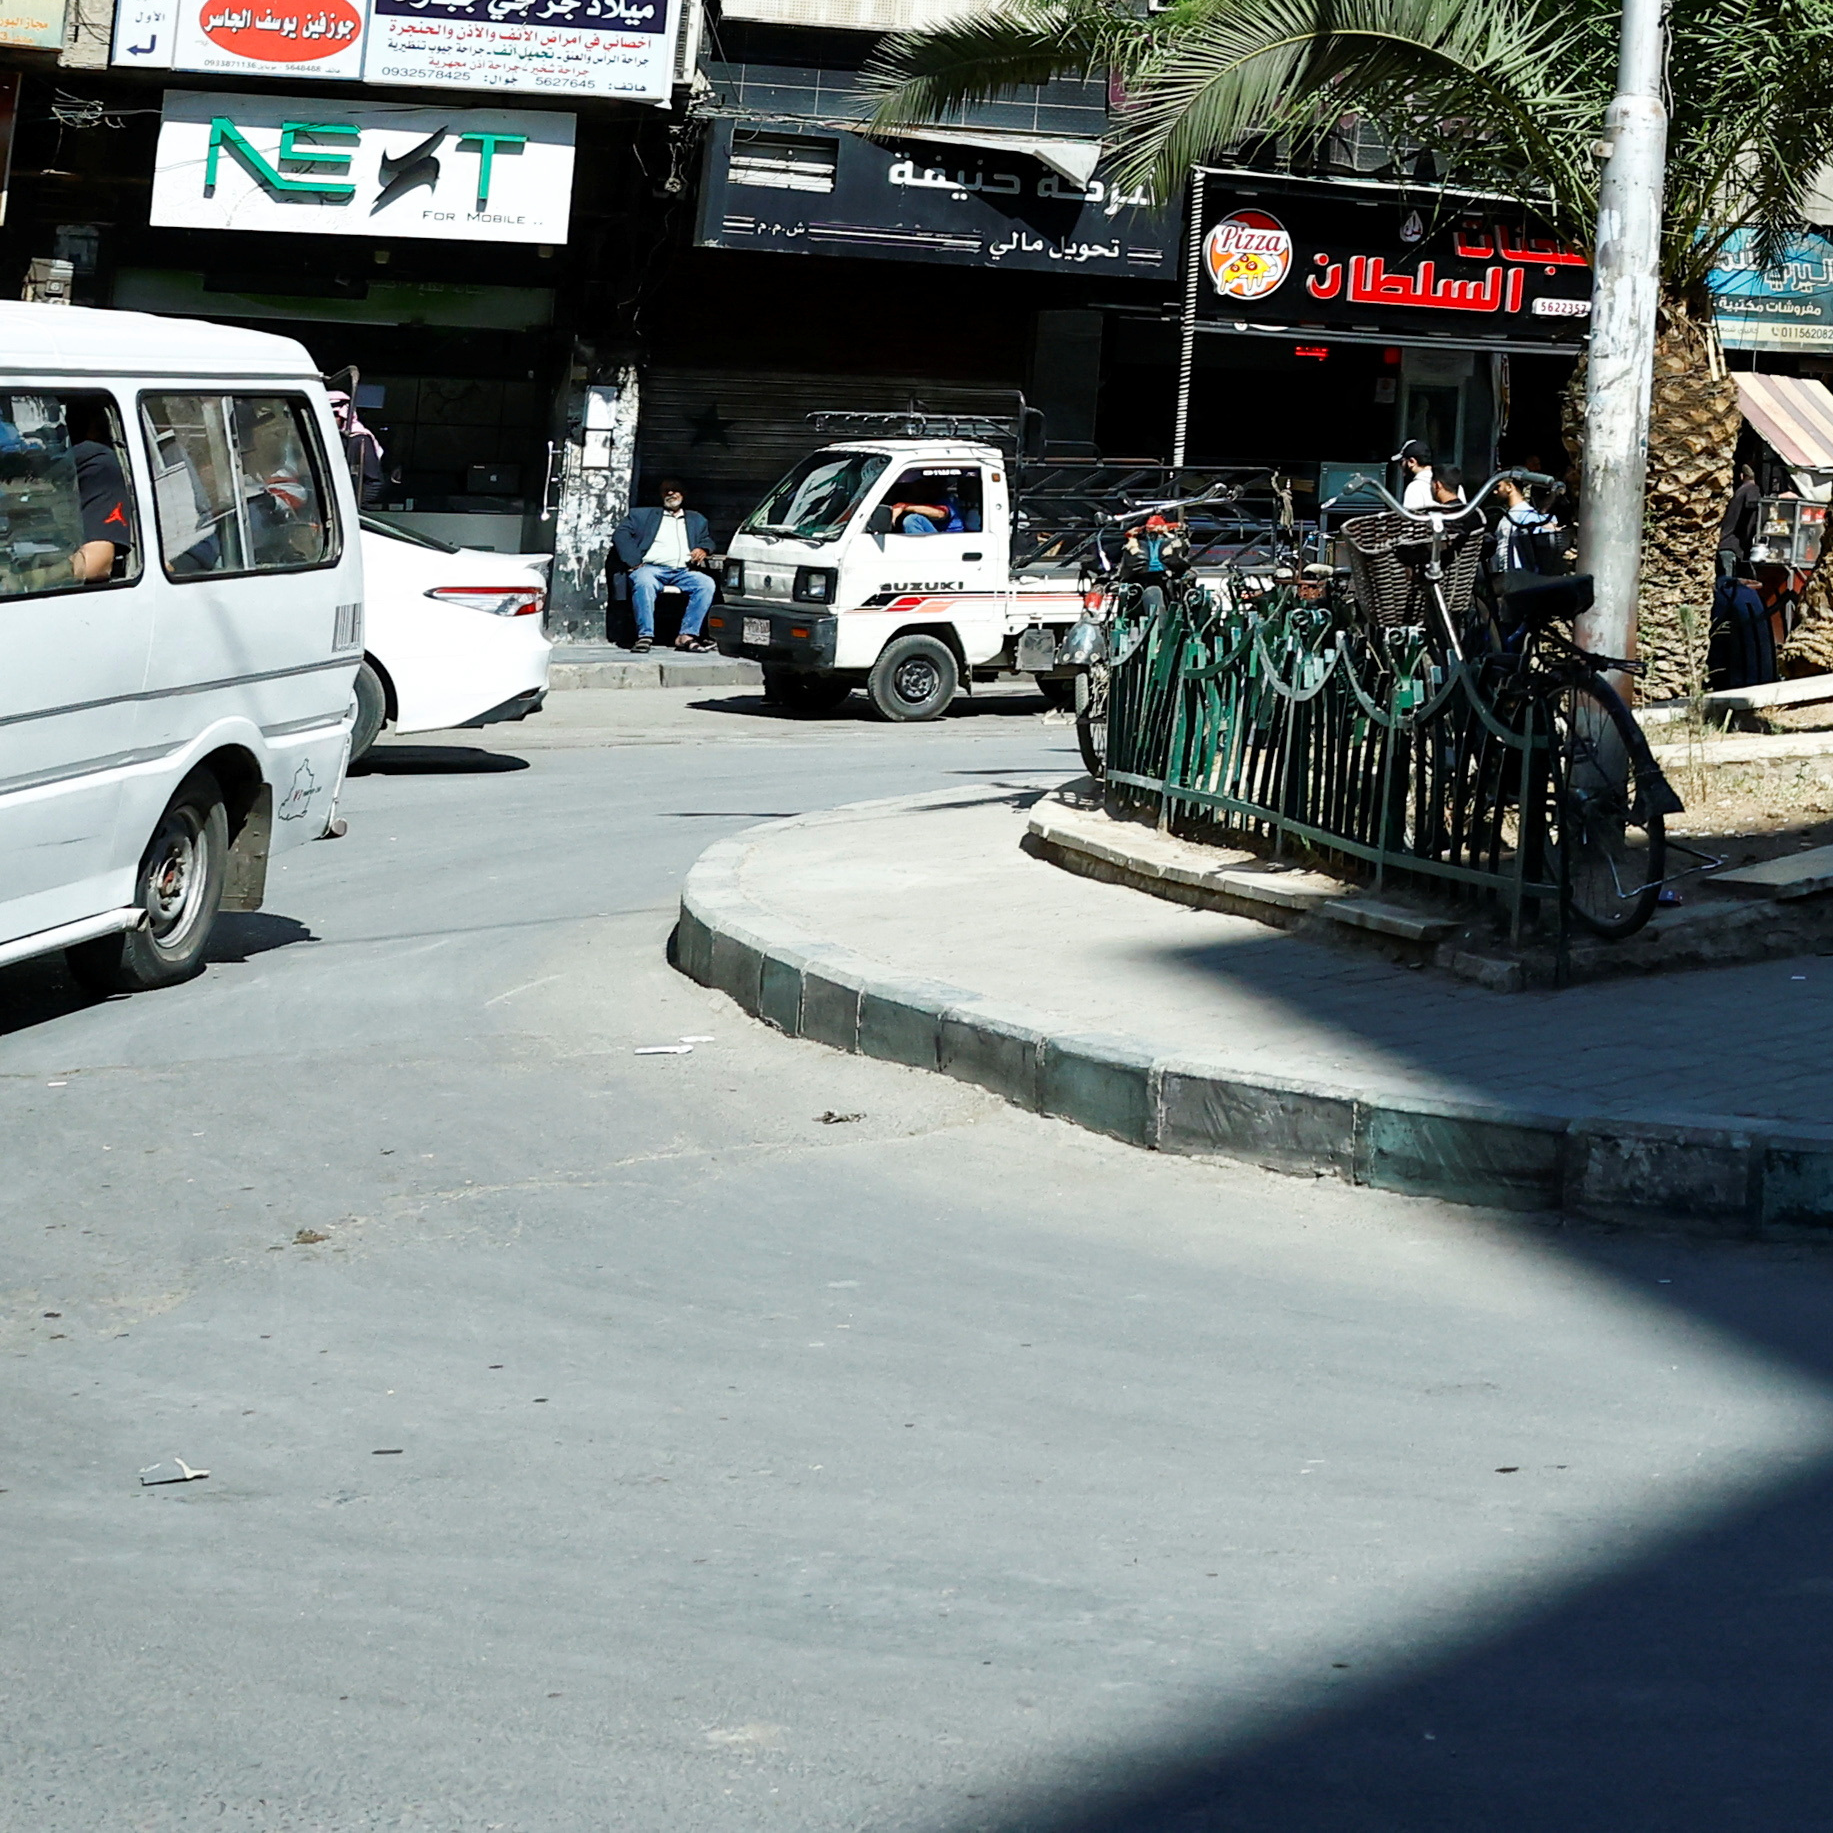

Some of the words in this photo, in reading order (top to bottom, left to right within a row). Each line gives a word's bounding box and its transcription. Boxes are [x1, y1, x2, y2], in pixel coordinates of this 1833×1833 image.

[203, 7, 252, 34] الجاسر
[254, 9, 298, 39] يوسف
[302, 11, 355, 41] جوزفين
[389, 19, 453, 40] والحنجرة
[499, 28, 538, 42] الأنف
[540, 33, 582, 48] أمراض
[584, 35, 602, 51] في
[604, 34, 652, 52] أخصائي
[381, 66, 471, 82] 0932578425
[535, 76, 596, 90] 5627645
[888, 151, 1021, 202] حنيفة
[988, 230, 1044, 261] مالي
[1047, 236, 1121, 263] تحويل
[1220, 228, 1283, 254] Pizza
[1306, 253, 1525, 314] السلطان
[1718, 297, 1764, 313] مكتبية
[1766, 300, 1821, 316] مفروشات
[880, 581, 964, 592] SUZUKI
